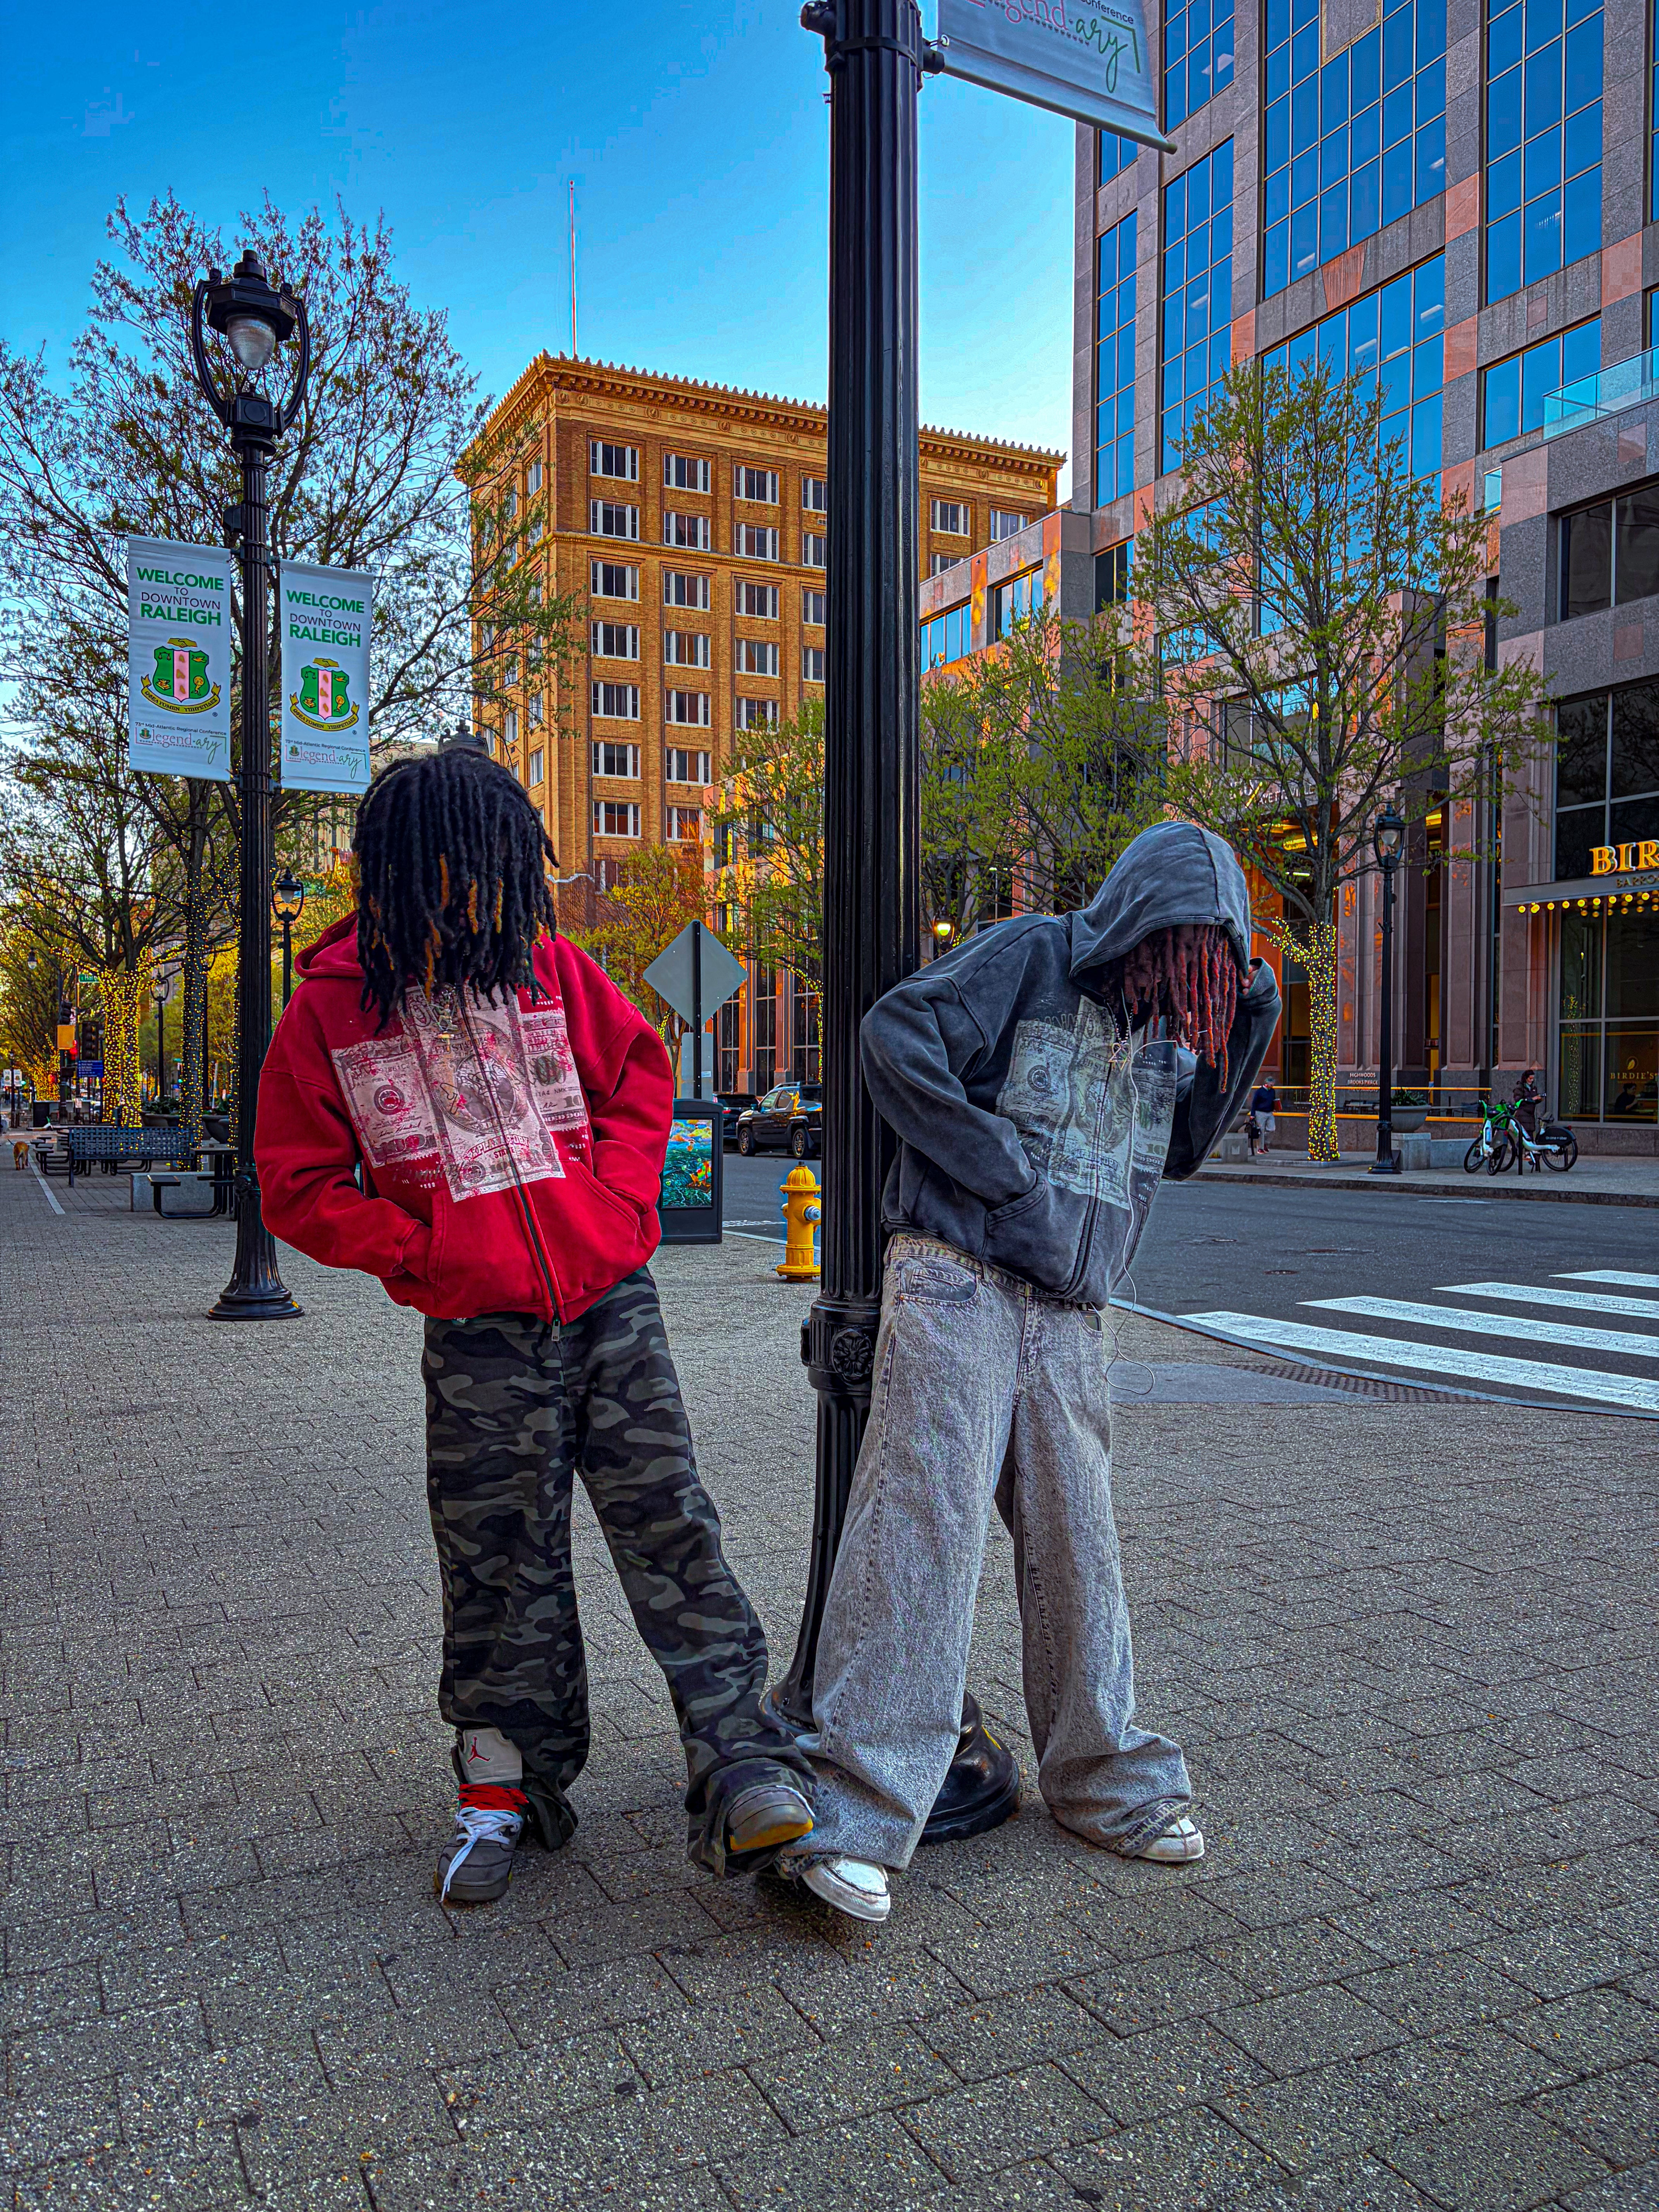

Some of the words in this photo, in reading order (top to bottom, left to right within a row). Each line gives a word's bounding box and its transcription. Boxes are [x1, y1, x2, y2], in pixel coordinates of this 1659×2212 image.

[1081, 0, 1134, 24] onference
[137, 567, 224, 591] WELCOME
[141, 592, 220, 610] DOWNTOWN
[174, 587, 188, 596] TO
[286, 589, 364, 613] WELCOME
[141, 603, 221, 626] RALEIGH
[290, 613, 361, 632] DOWNTOWN
[319, 609, 332, 617] TO
[290, 623, 361, 647] RALEIGH
[1589, 840, 1659, 876] BIR
[1616, 874, 1659, 888] BARRO
[1610, 1071, 1654, 1080] BIRDIE'S
